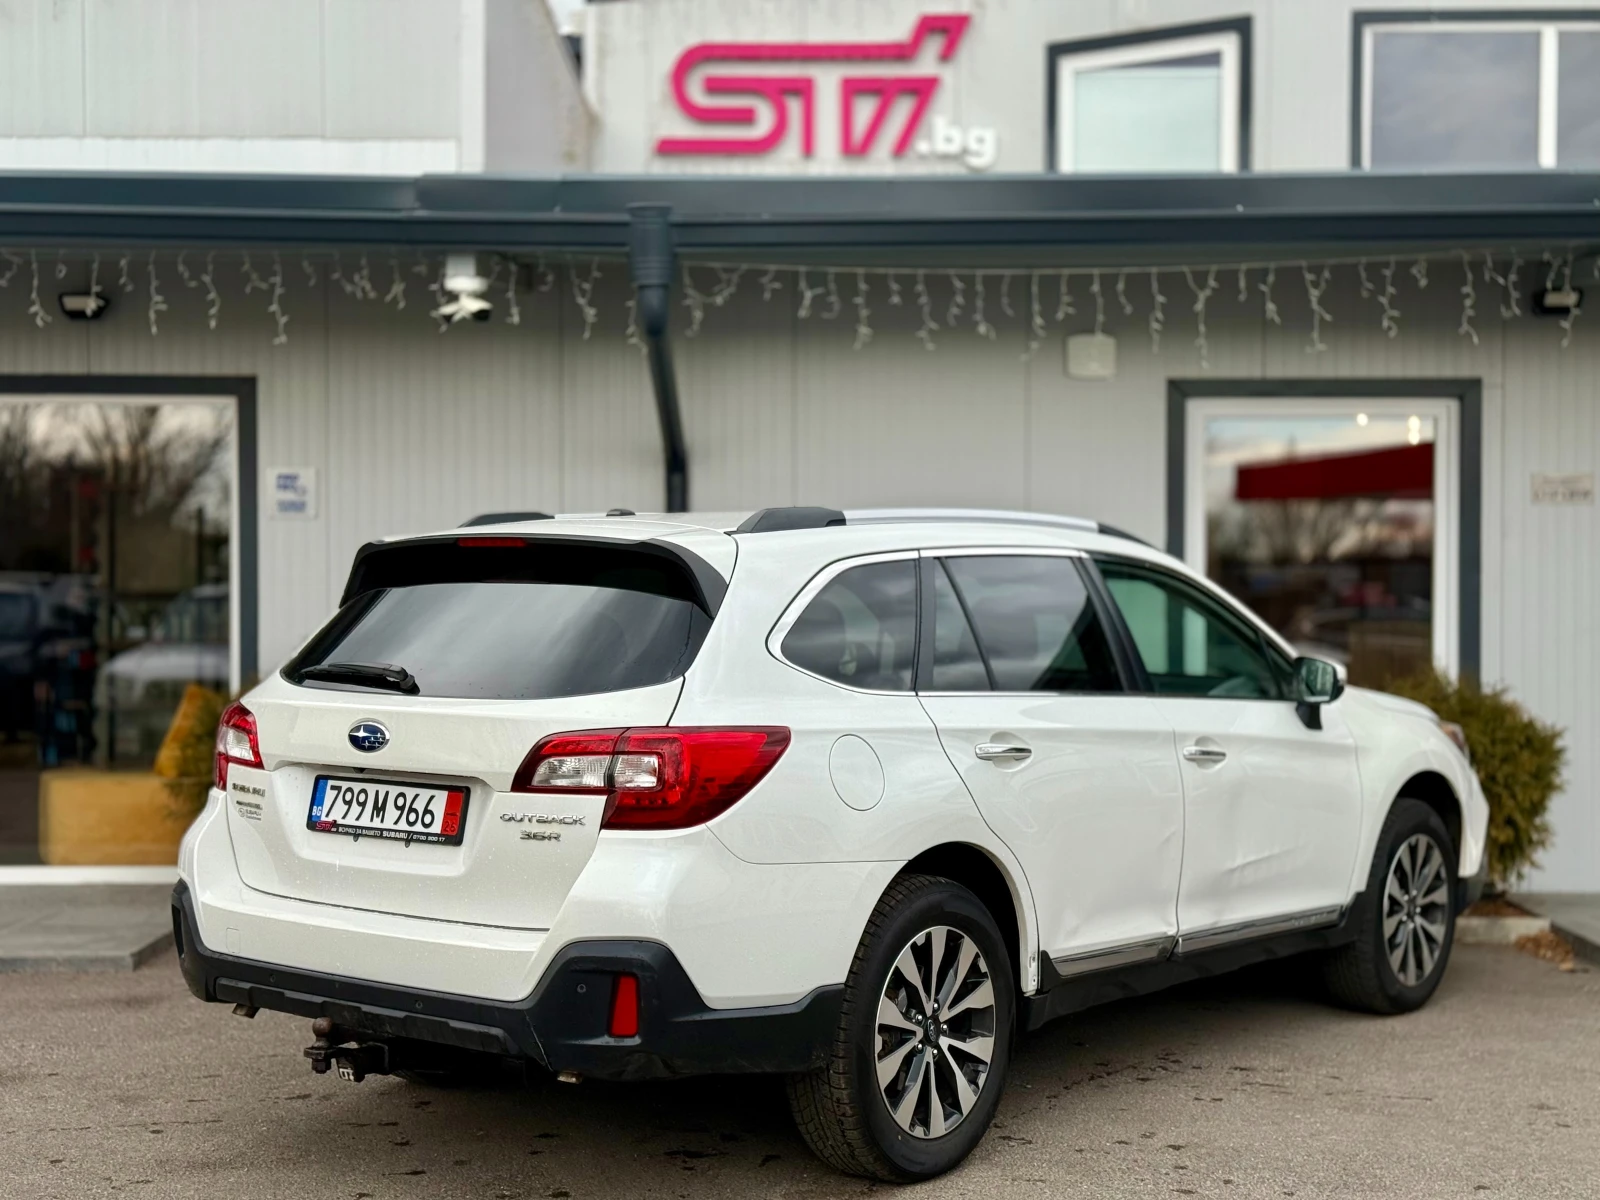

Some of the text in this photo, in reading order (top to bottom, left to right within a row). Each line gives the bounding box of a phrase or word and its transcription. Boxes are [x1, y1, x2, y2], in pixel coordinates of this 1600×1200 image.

[311, 805, 322, 816] BG
[325, 785, 436, 829] 799 M 966
[500, 812, 586, 826] OUTBACK
[382, 830, 408, 839] SUBARU
